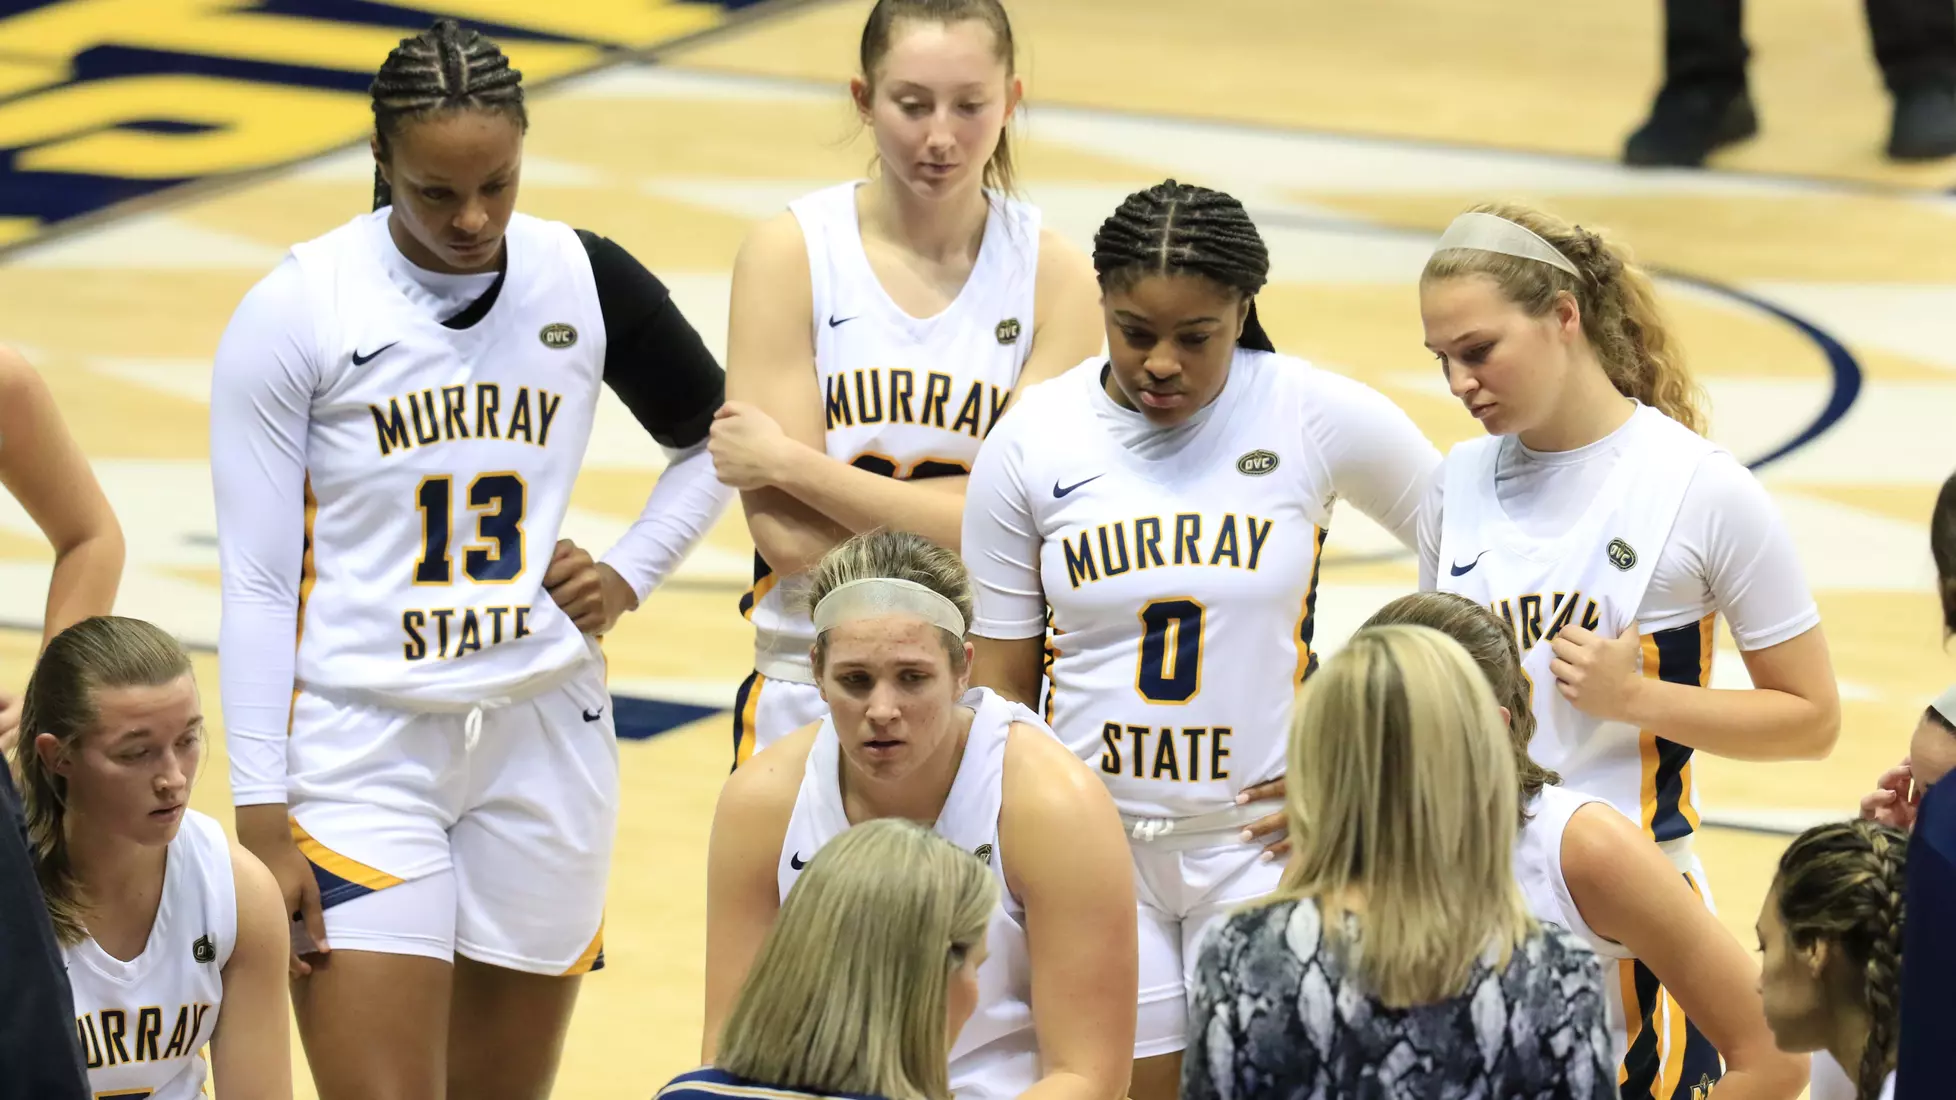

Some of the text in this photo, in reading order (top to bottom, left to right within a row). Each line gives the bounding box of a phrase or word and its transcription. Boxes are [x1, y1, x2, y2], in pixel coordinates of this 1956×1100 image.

[546, 330, 570, 342] OVC
[368, 382, 562, 457] MURRAY
[825, 367, 1013, 441] MURRAY
[1245, 457, 1270, 470] OVC
[412, 470, 528, 586] 13
[1061, 512, 1274, 591] MURRAY
[1610, 544, 1630, 565] OVC
[1134, 595, 1207, 705] 0
[1100, 719, 1233, 783] STATE
[76, 1002, 212, 1069] URRAY
